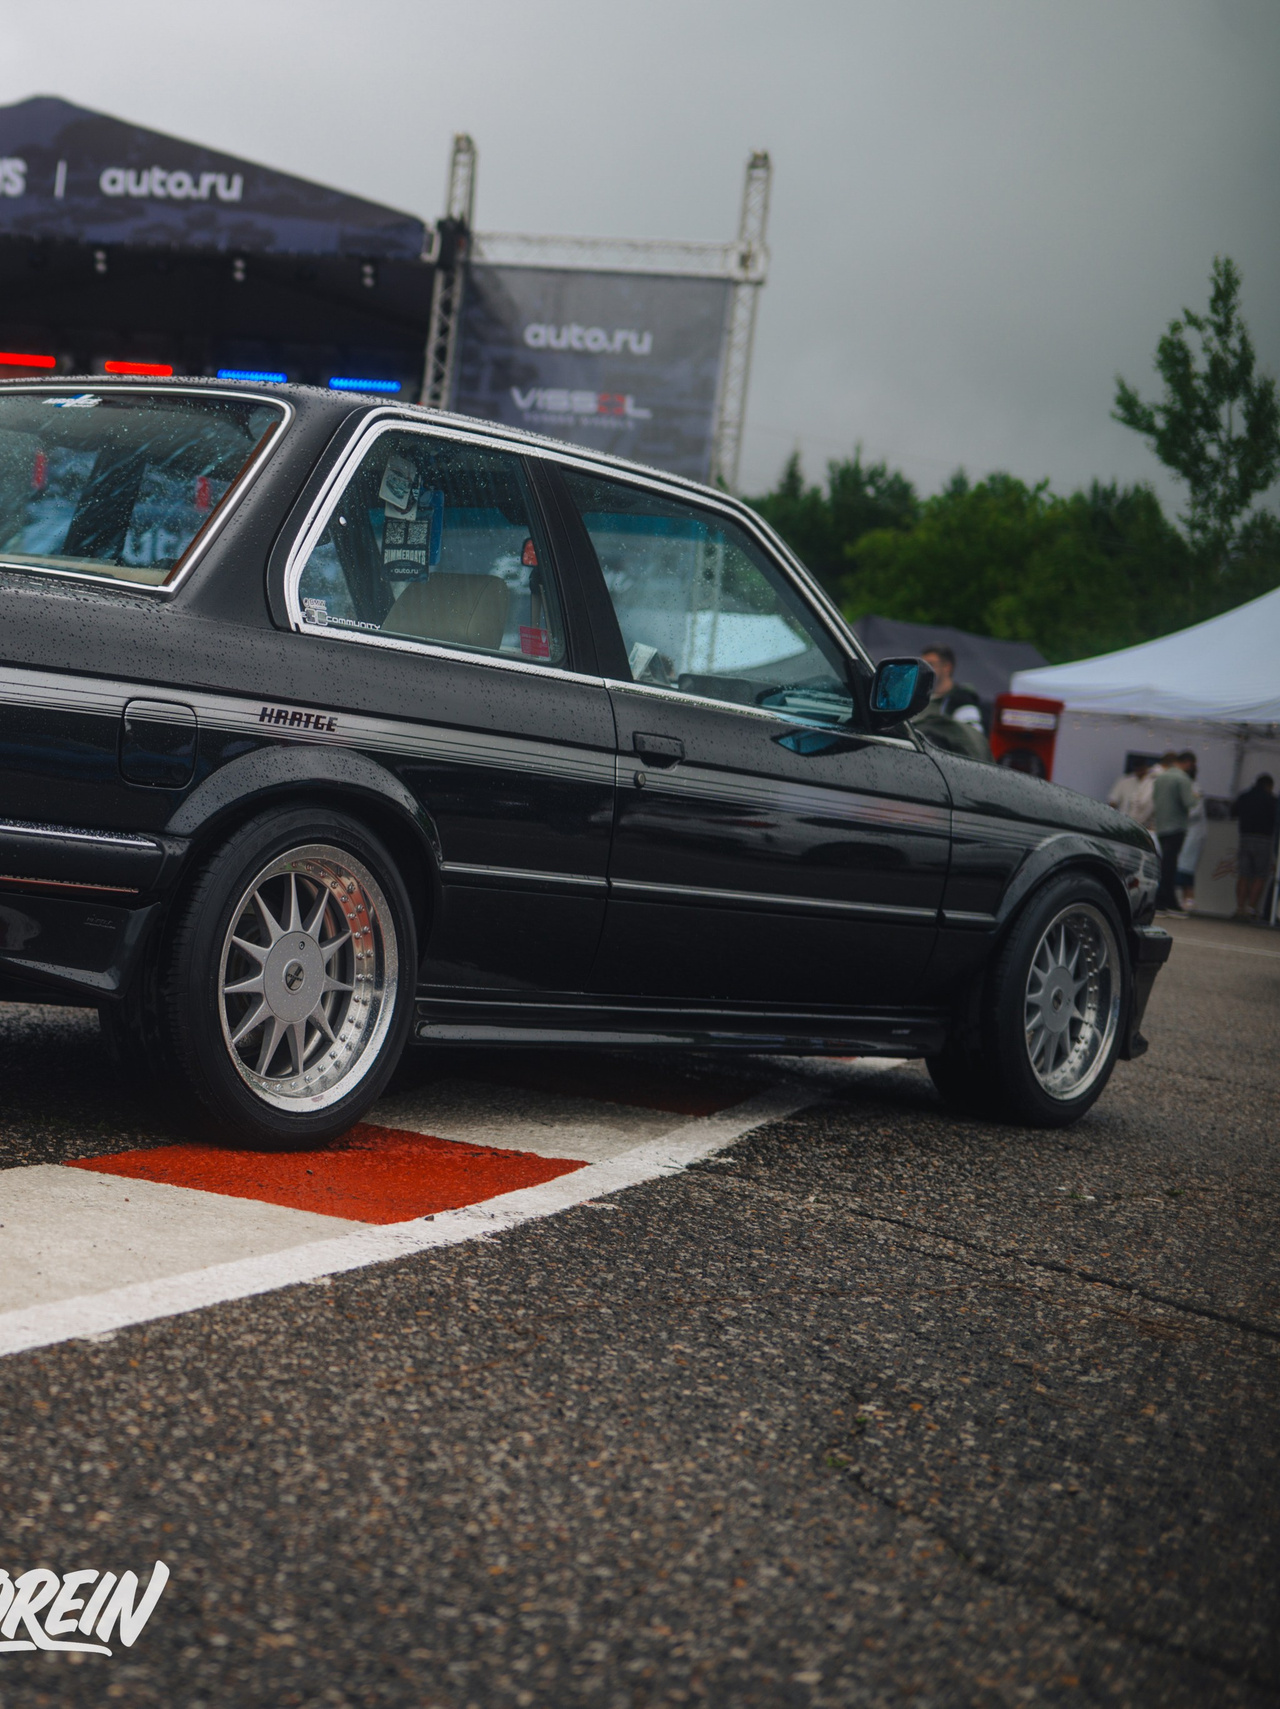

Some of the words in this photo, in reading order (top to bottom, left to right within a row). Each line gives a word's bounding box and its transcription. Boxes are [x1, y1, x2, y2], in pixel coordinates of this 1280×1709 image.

[100, 165, 242, 201] auto.ru
[524, 322, 652, 355] auto.ru
[259, 707, 338, 732] HARTGE
